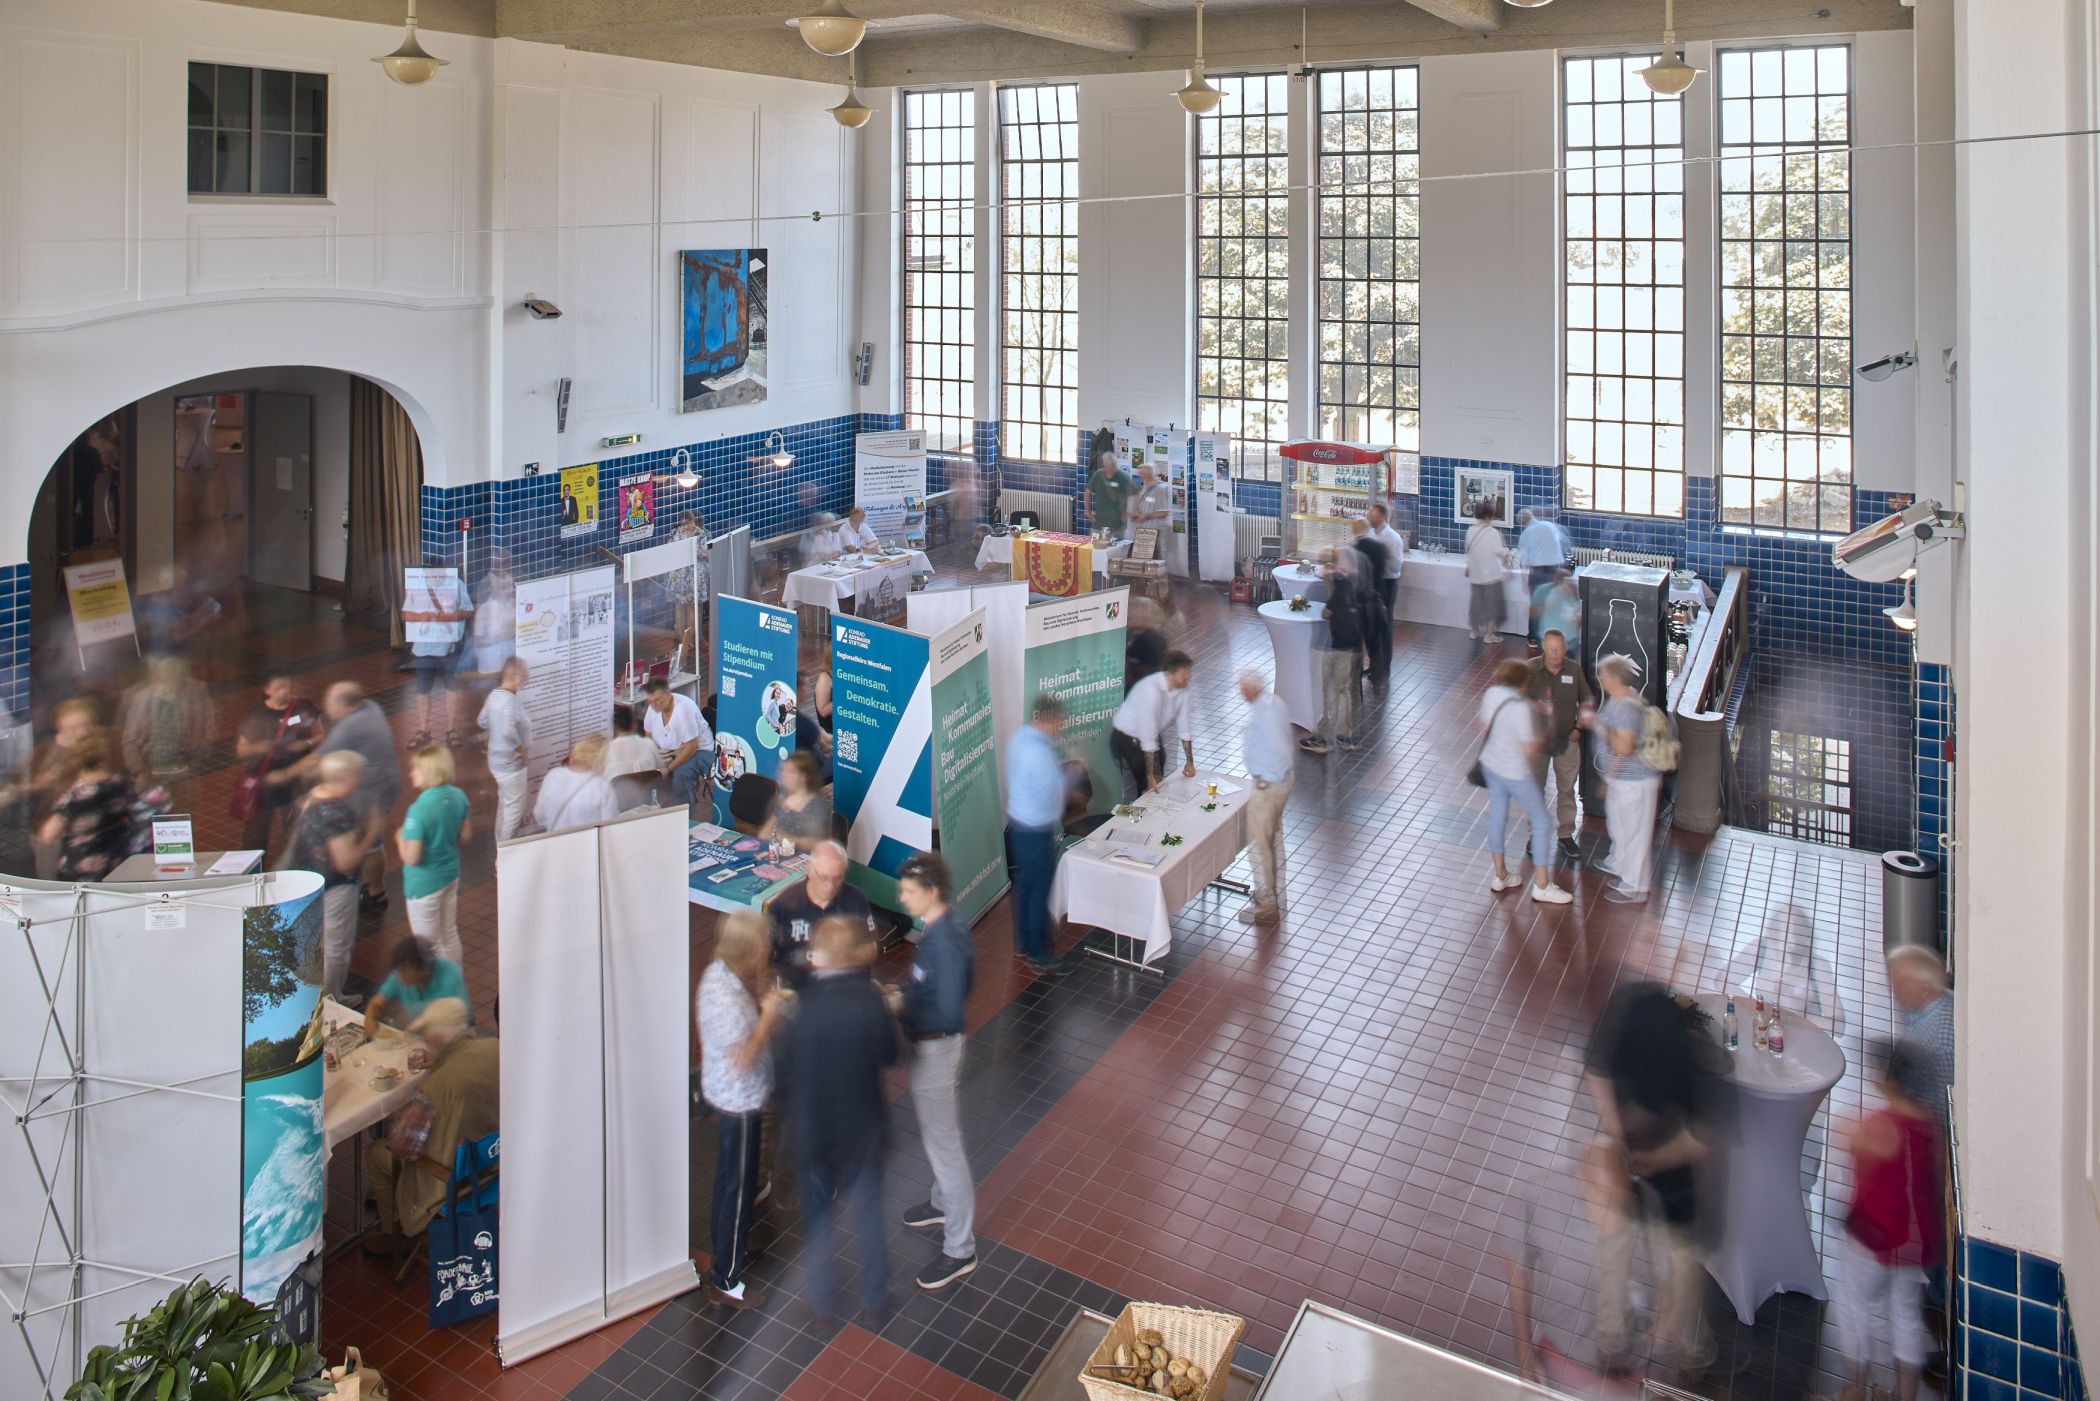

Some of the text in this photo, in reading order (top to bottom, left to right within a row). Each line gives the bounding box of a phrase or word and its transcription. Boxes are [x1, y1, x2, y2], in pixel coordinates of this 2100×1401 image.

[848, 629, 865, 637] KONRAD
[848, 634, 871, 645] ADENAUER
[723, 640, 774, 661] Studieren mit
[848, 640, 869, 649] STIFTUNG
[723, 652, 765, 671] Stipendium
[836, 651, 892, 672] Regionalbüro Westfalen
[836, 668, 889, 693] Gemeinsam.
[1039, 668, 1080, 690] Heimat
[1046, 676, 1122, 703] Kommunales
[846, 690, 900, 715] Demokratie.
[837, 706, 880, 728] Gestalten.
[942, 701, 968, 731] Heimat
[947, 702, 992, 743] Kommunales
[941, 748, 955, 767] Bau
[944, 735, 994, 784] Digitalisierung
[693, 846, 739, 862] ADENAUER
[701, 842, 735, 855] KONRAD
